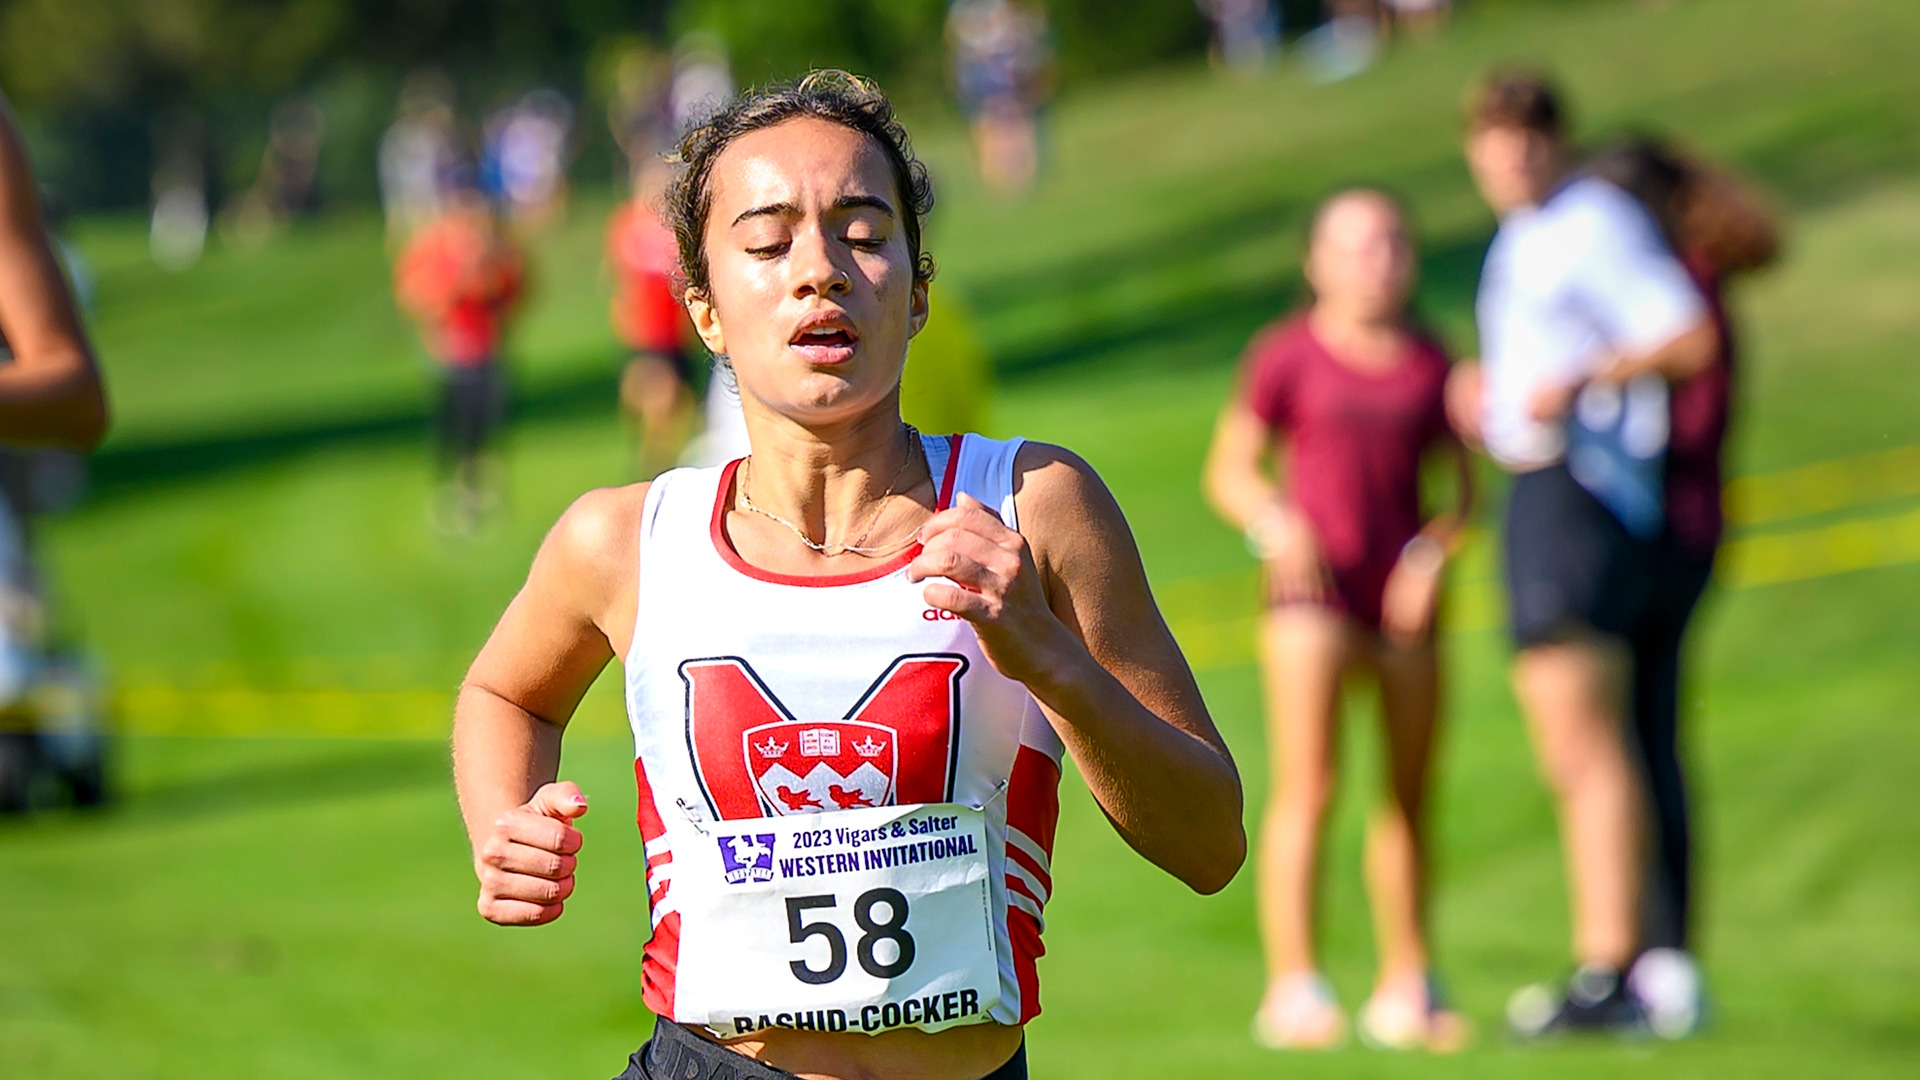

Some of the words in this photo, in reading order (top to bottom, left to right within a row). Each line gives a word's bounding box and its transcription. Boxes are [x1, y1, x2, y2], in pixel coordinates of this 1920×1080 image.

[793, 830, 832, 849] 2023
[835, 827, 887, 848] Vigars
[891, 820, 906, 838] &
[908, 816, 958, 835] Salter
[779, 851, 860, 878] WESTERN
[864, 834, 977, 871] INVITATIONAL
[785, 888, 916, 985] 58
